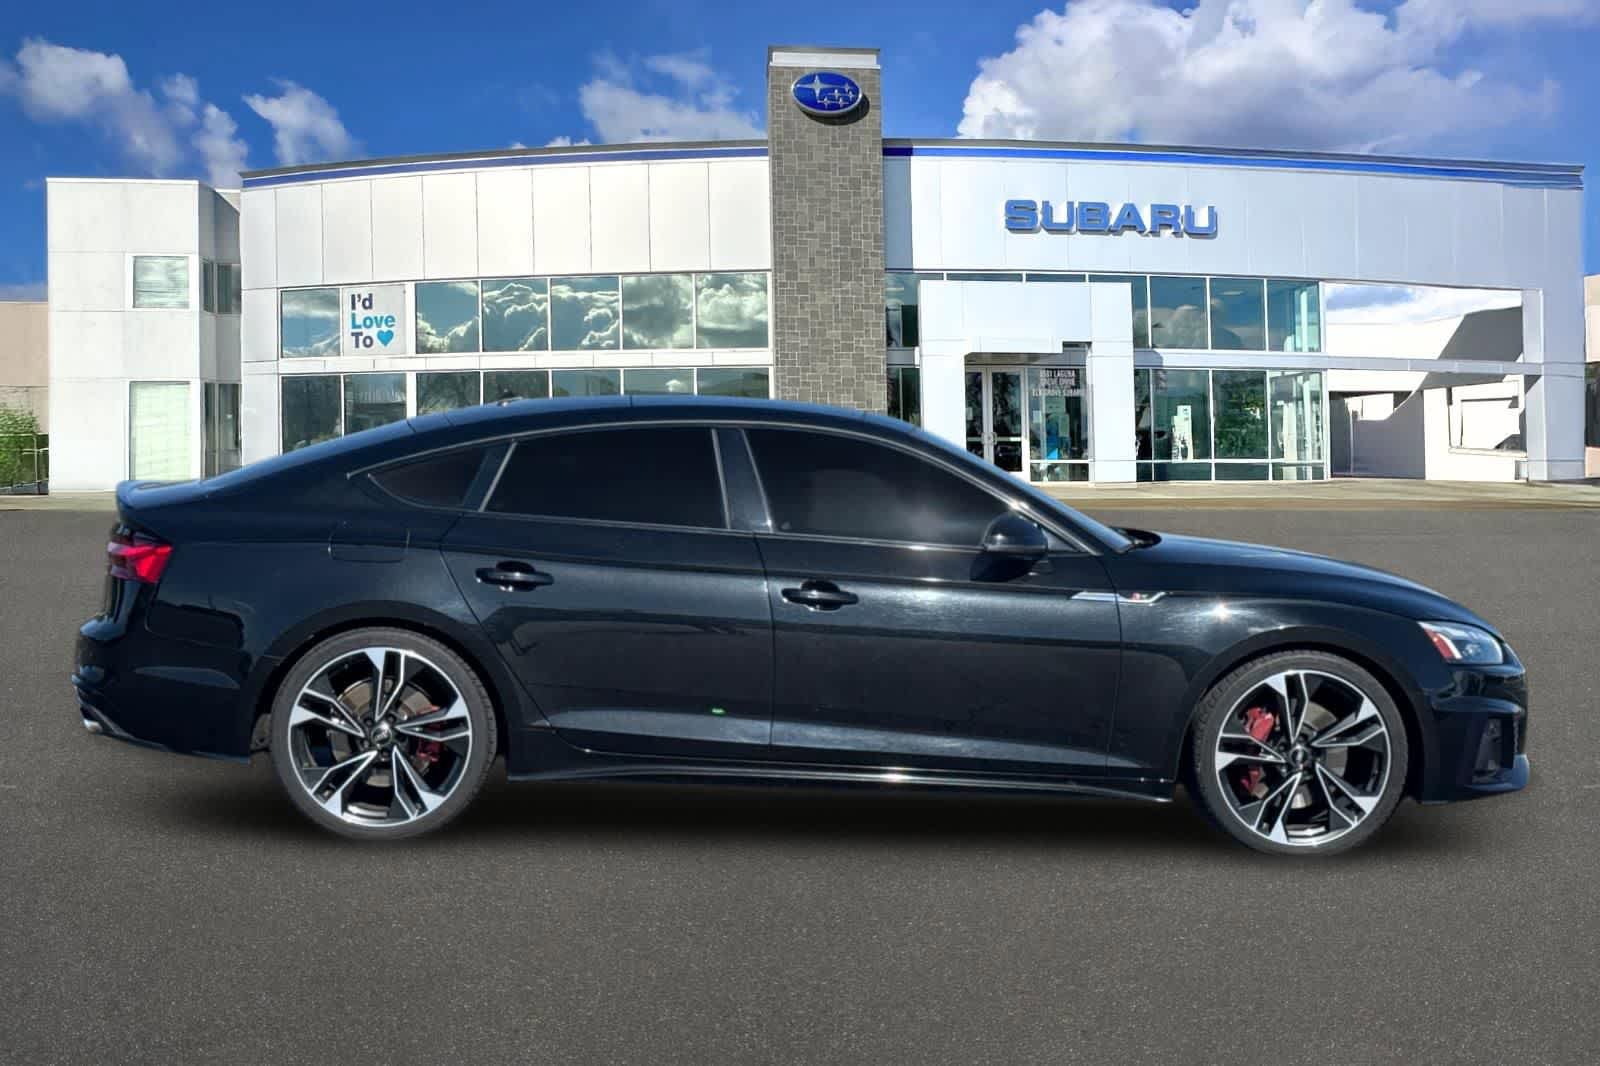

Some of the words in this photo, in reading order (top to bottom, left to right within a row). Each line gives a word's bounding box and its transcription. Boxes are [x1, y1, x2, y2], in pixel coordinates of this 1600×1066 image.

[1005, 199, 1218, 239] SUBARU
[351, 293, 373, 310] I'd
[351, 312, 396, 329] Love
[351, 331, 374, 348] To
